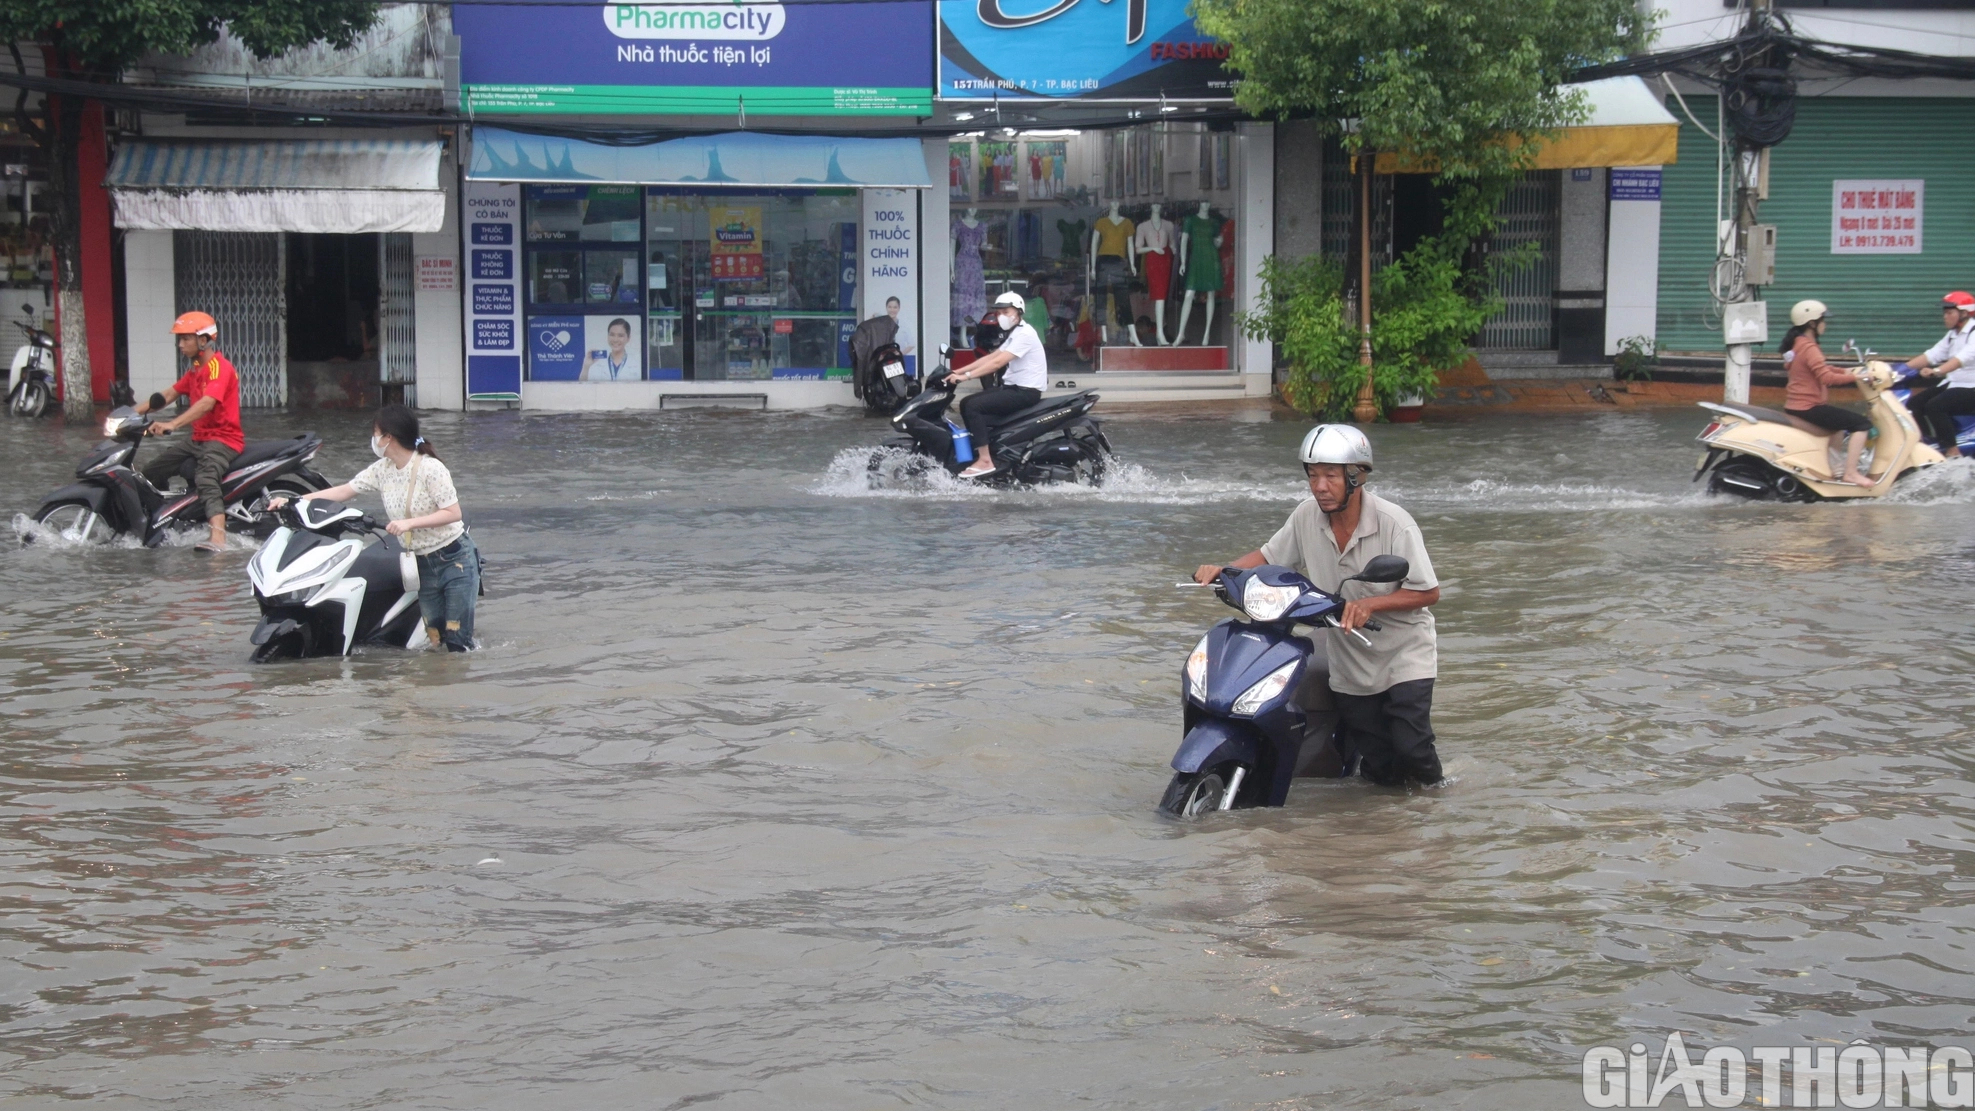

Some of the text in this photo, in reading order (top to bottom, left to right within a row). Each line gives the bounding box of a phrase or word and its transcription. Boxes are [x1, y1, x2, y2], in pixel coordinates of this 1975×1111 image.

[616, 5, 772, 35] Pharmacity
[617, 43, 771, 67] Nhà thuốc tiện lợi
[1151, 43, 1234, 60] FASHIO
[1031, 80, 1037, 89] 7
[1046, 80, 1059, 89] TP.
[1061, 80, 1077, 90] BẠC
[1080, 78, 1099, 89] LIÊU
[468, 197, 516, 207] CHÚNG TÔI
[476, 210, 508, 218] CÓ BÁN
[874, 211, 904, 221] 100%
[482, 225, 503, 233] THUỐC
[868, 225, 911, 240] THUỐC
[719, 232, 752, 240] Vitamin
[482, 252, 503, 260] THUỐC
[870, 246, 909, 259] CHÍNH
[872, 264, 908, 277] HÃNG
[152, 516, 173, 529] HONDA
[350, 583, 364, 592] HONDA
